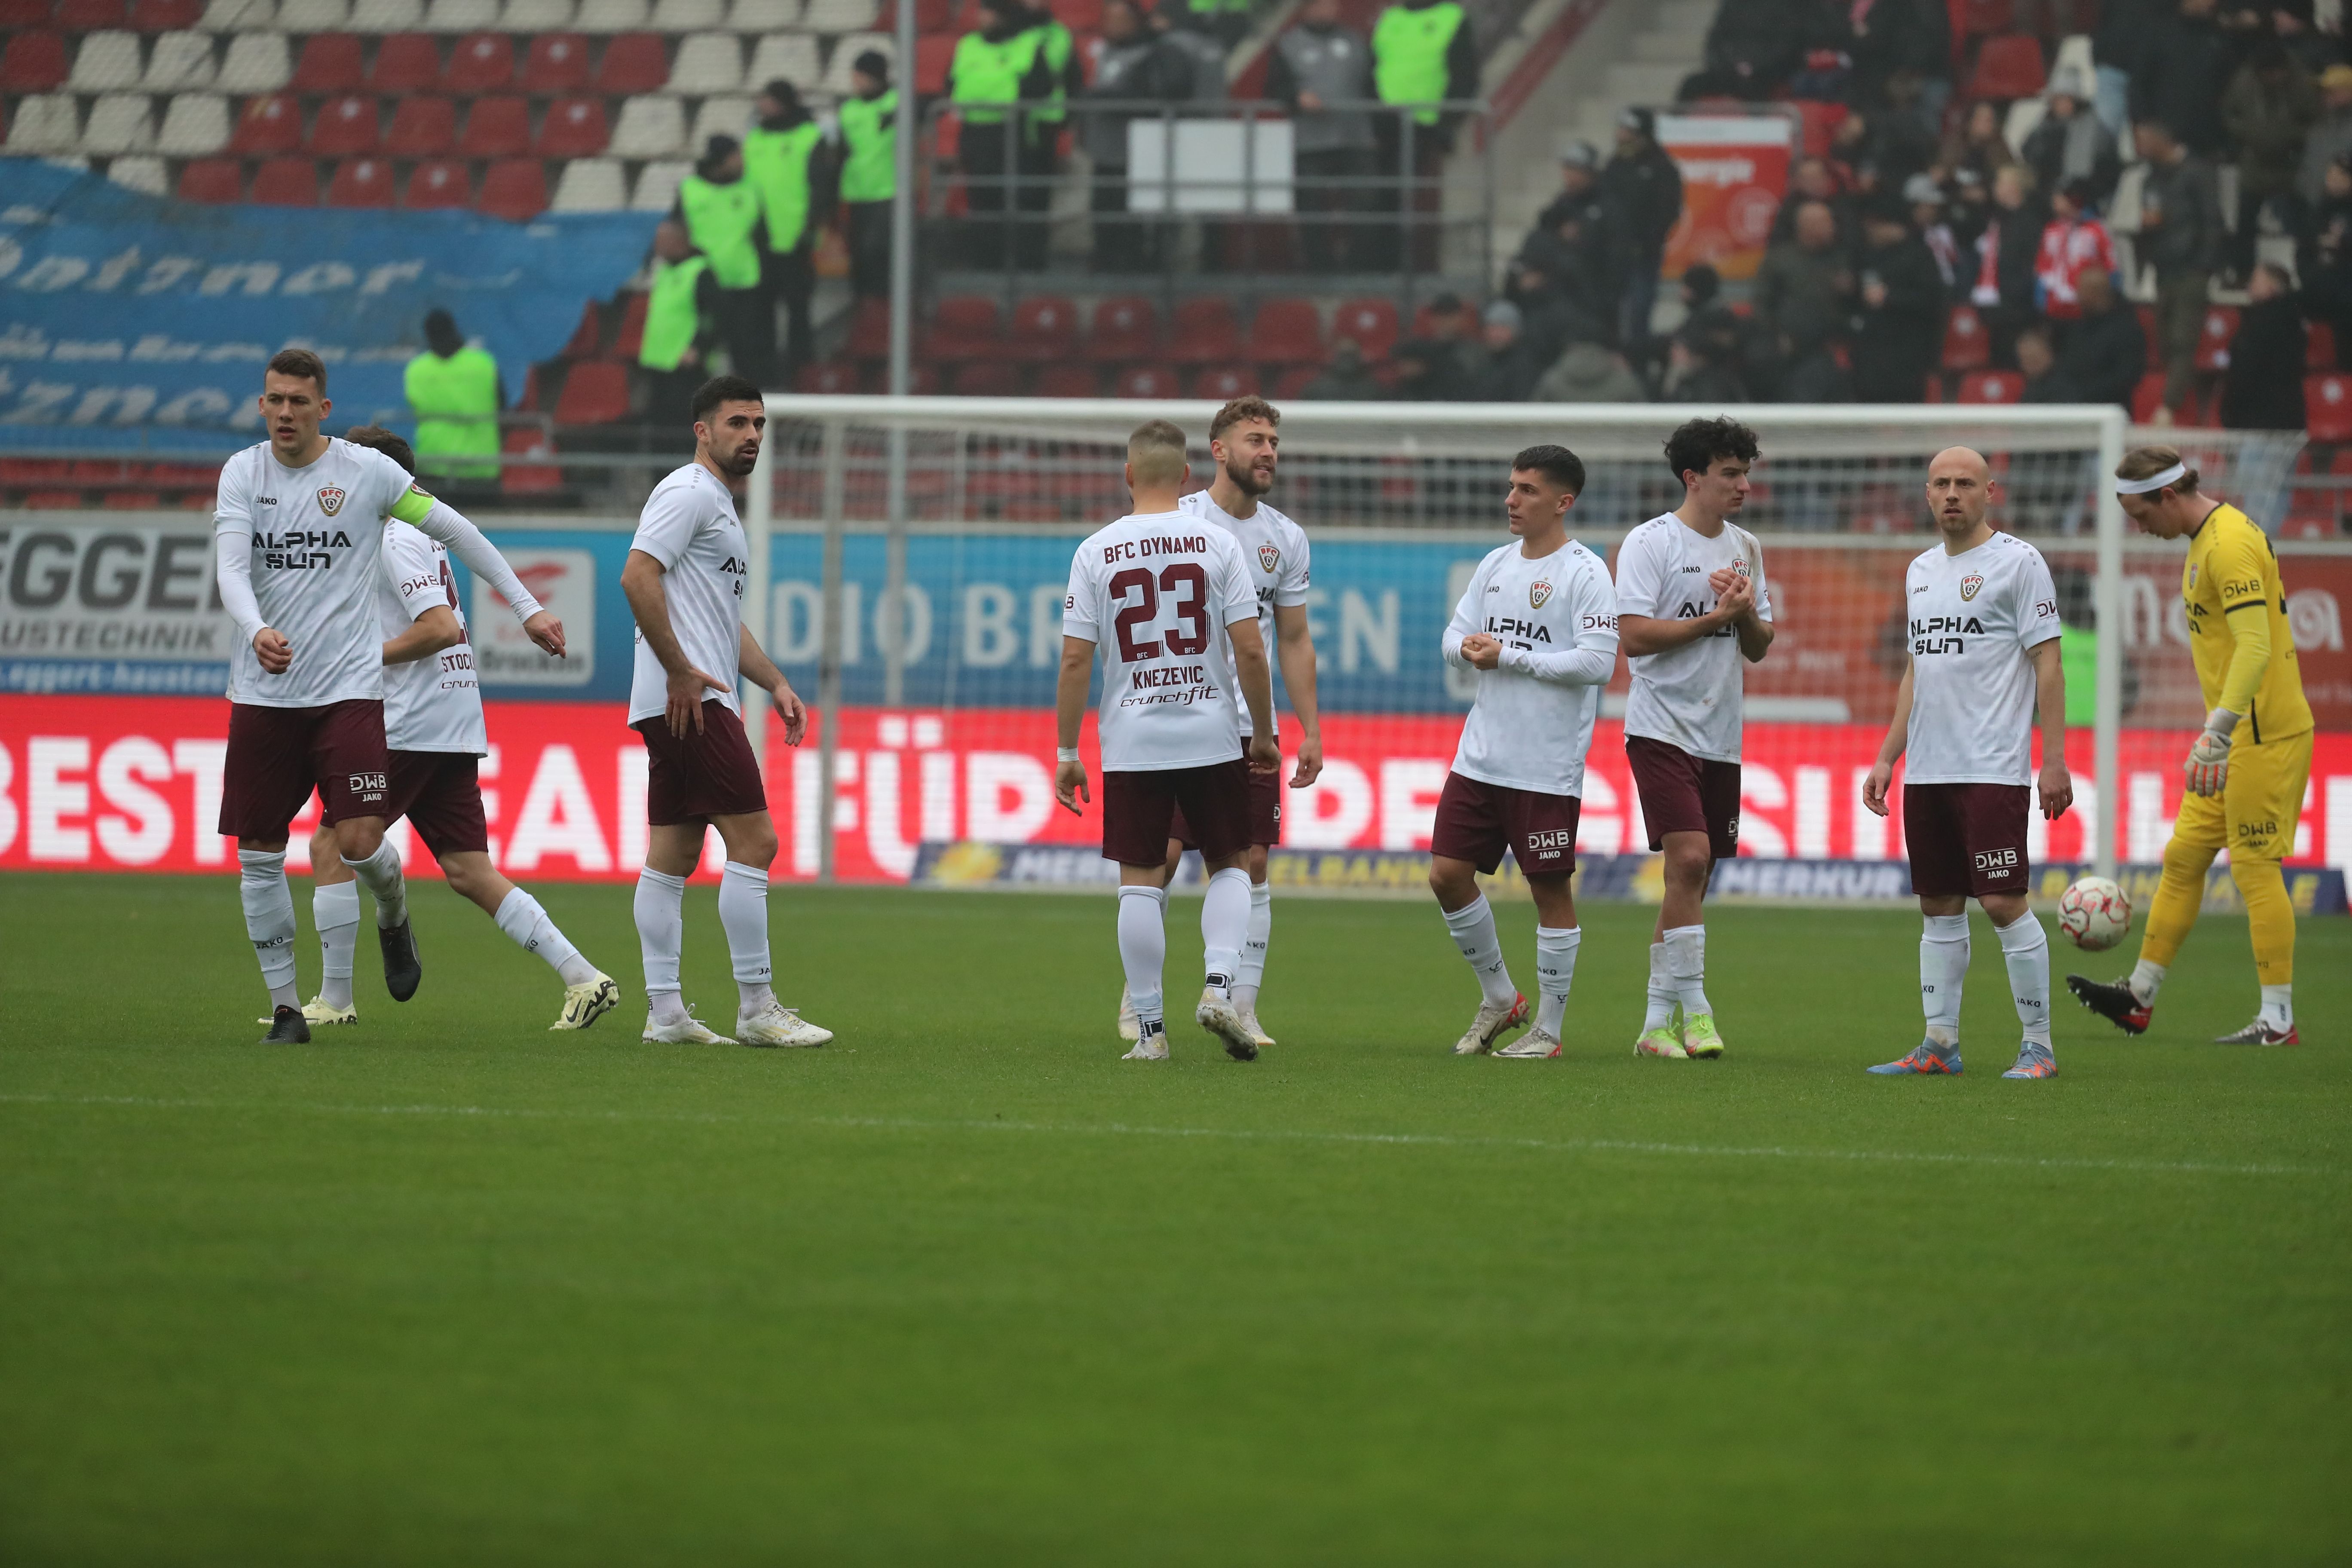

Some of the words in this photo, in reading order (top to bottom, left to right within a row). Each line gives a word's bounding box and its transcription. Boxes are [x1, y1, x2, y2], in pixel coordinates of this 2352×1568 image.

[257, 496, 277, 505] JAKO
[320, 489, 342, 498] BFC
[252, 531, 352, 549] ALPHA
[1104, 542, 1136, 564] BFC
[1140, 536, 1206, 557] DYNAMO
[1260, 547, 1277, 557] BFC
[0, 530, 228, 612] GGE
[1734, 561, 1748, 570] BFC
[1534, 583, 1551, 593] BFC
[1964, 577, 1981, 585] BFC
[1913, 585, 1929, 594] JAKO
[2224, 580, 2260, 598] DWB
[1109, 563, 1210, 663] 23
[772, 579, 934, 667] DIO
[1583, 616, 1618, 631] DWB
[1133, 666, 1204, 690] KNEZEVIC
[1120, 686, 1219, 707] crunchfit
[349, 775, 386, 791] DWB
[362, 793, 382, 802] JAKO
[2238, 821, 2278, 836] DWB
[1528, 831, 1569, 850] DWB
[1539, 851, 1561, 860] JAKO
[1975, 850, 2018, 869] DWB
[1718, 861, 1904, 900] MERKUR
[1987, 869, 2009, 879] JAKO
[256, 936, 283, 949] JAKO
[2017, 997, 2041, 1008] JAKO
